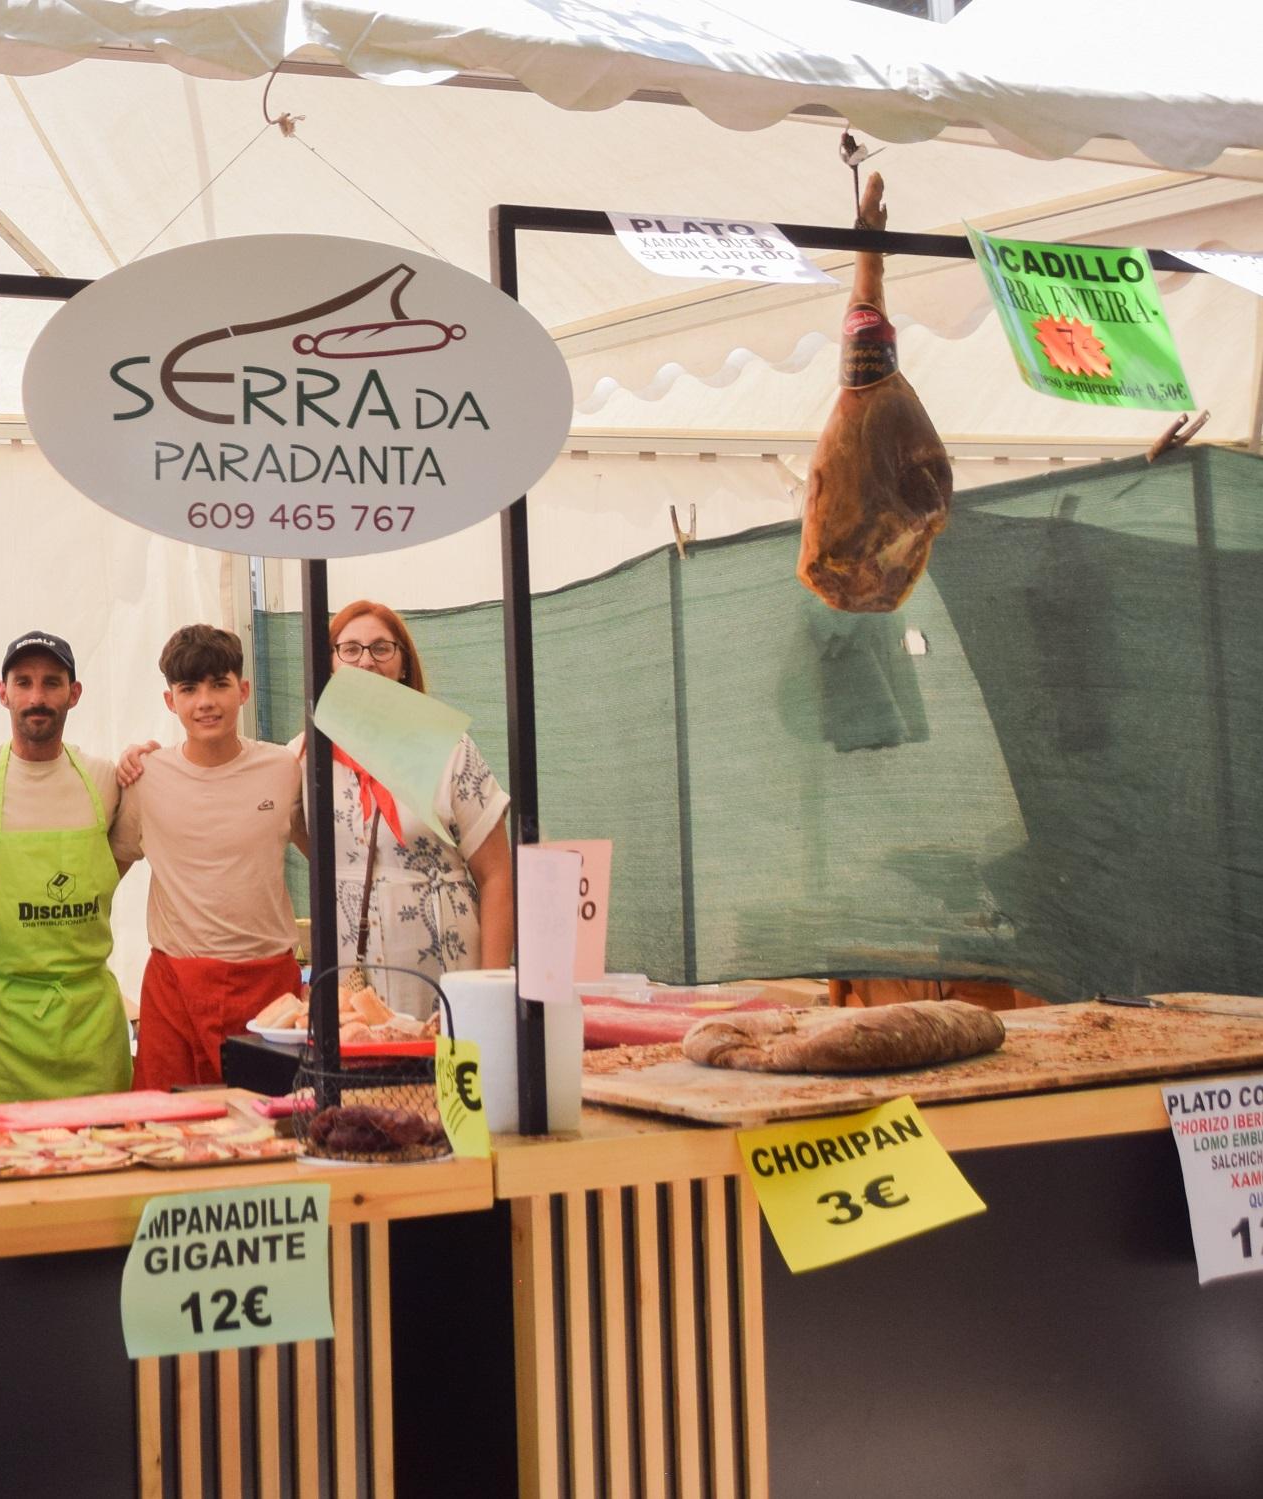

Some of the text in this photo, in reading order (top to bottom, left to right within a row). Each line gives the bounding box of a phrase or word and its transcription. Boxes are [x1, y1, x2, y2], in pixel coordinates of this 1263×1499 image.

[629, 218, 755, 236] PLATO
[705, 238, 716, 249] E
[718, 238, 774, 250] QUESO
[640, 250, 795, 261] SEMICURADO
[980, 238, 1145, 283] OCADILLO
[110, 326, 490, 430] SERRA DA
[155, 441, 447, 486] PARADANTA
[187, 502, 416, 532] 609 465 767
[1167, 1088, 1232, 1115] PLATO
[751, 1114, 923, 1177] CHORIPAN
[1193, 1135, 1228, 1152] LOMO
[137, 1196, 319, 1241] MPANADILLA
[817, 1174, 910, 1225] 3€
[144, 1232, 305, 1275] GIGANTE
[180, 1285, 272, 1334] 12€
